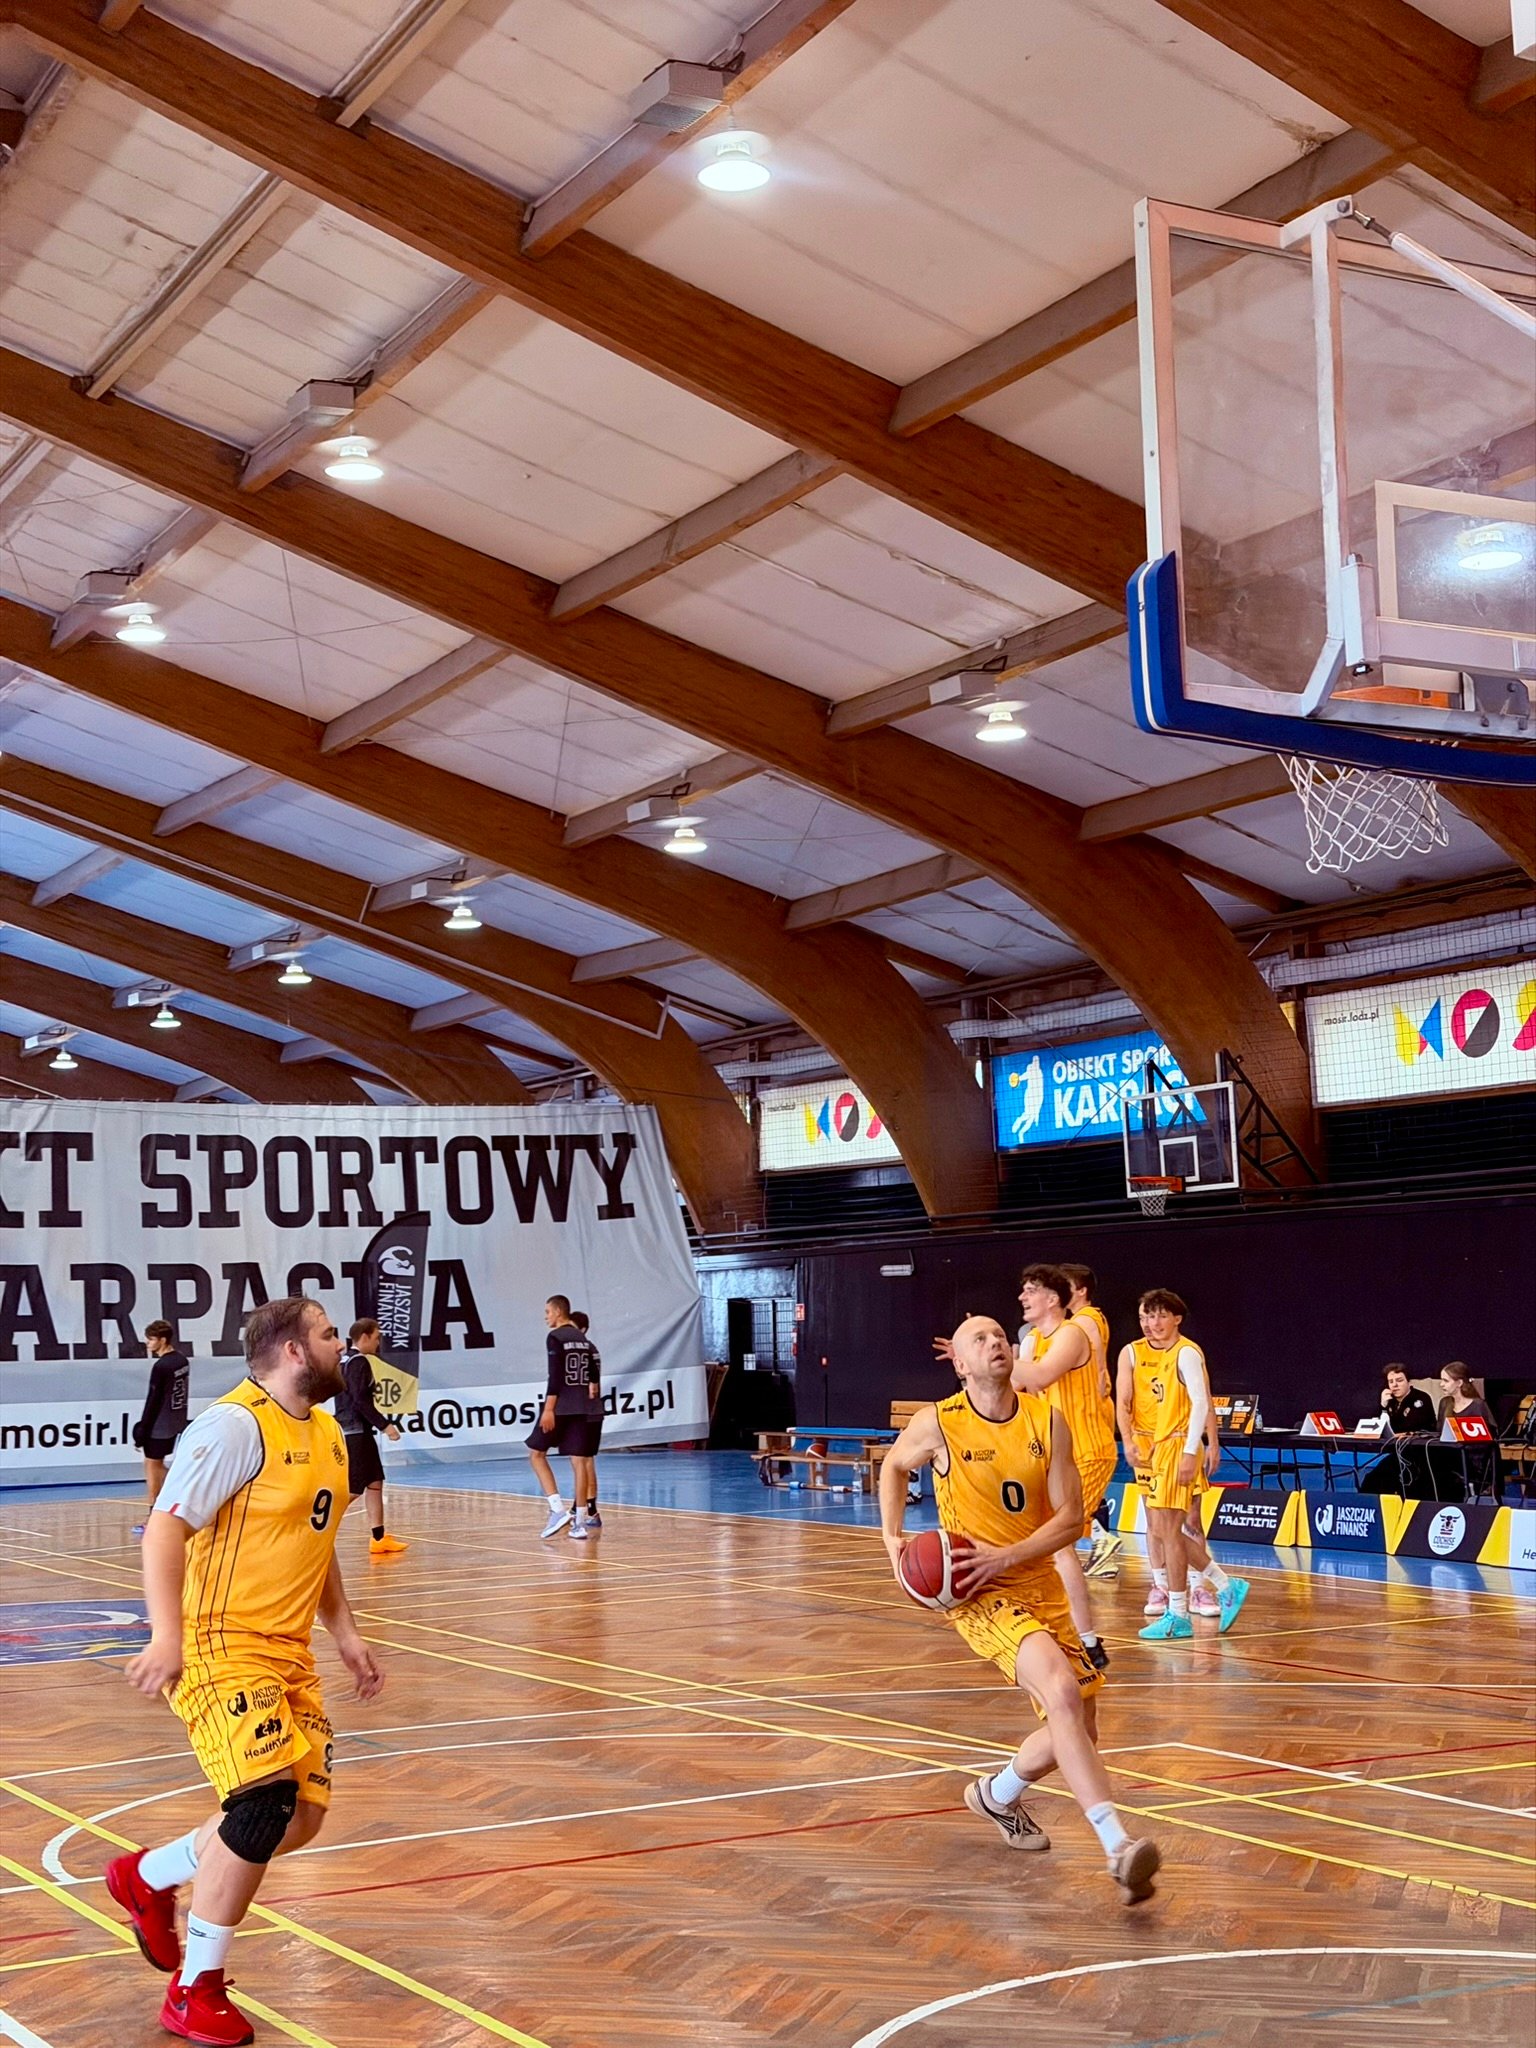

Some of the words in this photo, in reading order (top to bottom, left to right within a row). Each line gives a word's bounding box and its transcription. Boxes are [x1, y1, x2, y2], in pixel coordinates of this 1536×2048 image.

[1052, 1053, 1117, 1084] OBIEKT
[1121, 1043, 1177, 1075] SPOR
[140, 1132, 637, 1229] SPORTOWY
[0, 1259, 495, 1361] ARPAA
[391, 1282, 413, 1349] JASZCZAK
[0, 1412, 130, 1450] mosir.l
[1319, 1416, 1341, 1431] 5
[1461, 1421, 1487, 1438] 5
[310, 1488, 333, 1532] 9
[1001, 1480, 1025, 1513] 0
[1219, 1503, 1279, 1516] ATHLETIC
[1218, 1515, 1278, 1529] TRAINING
[1336, 1506, 1376, 1524] JASZCZAK
[1521, 1548, 1536, 1561] He
